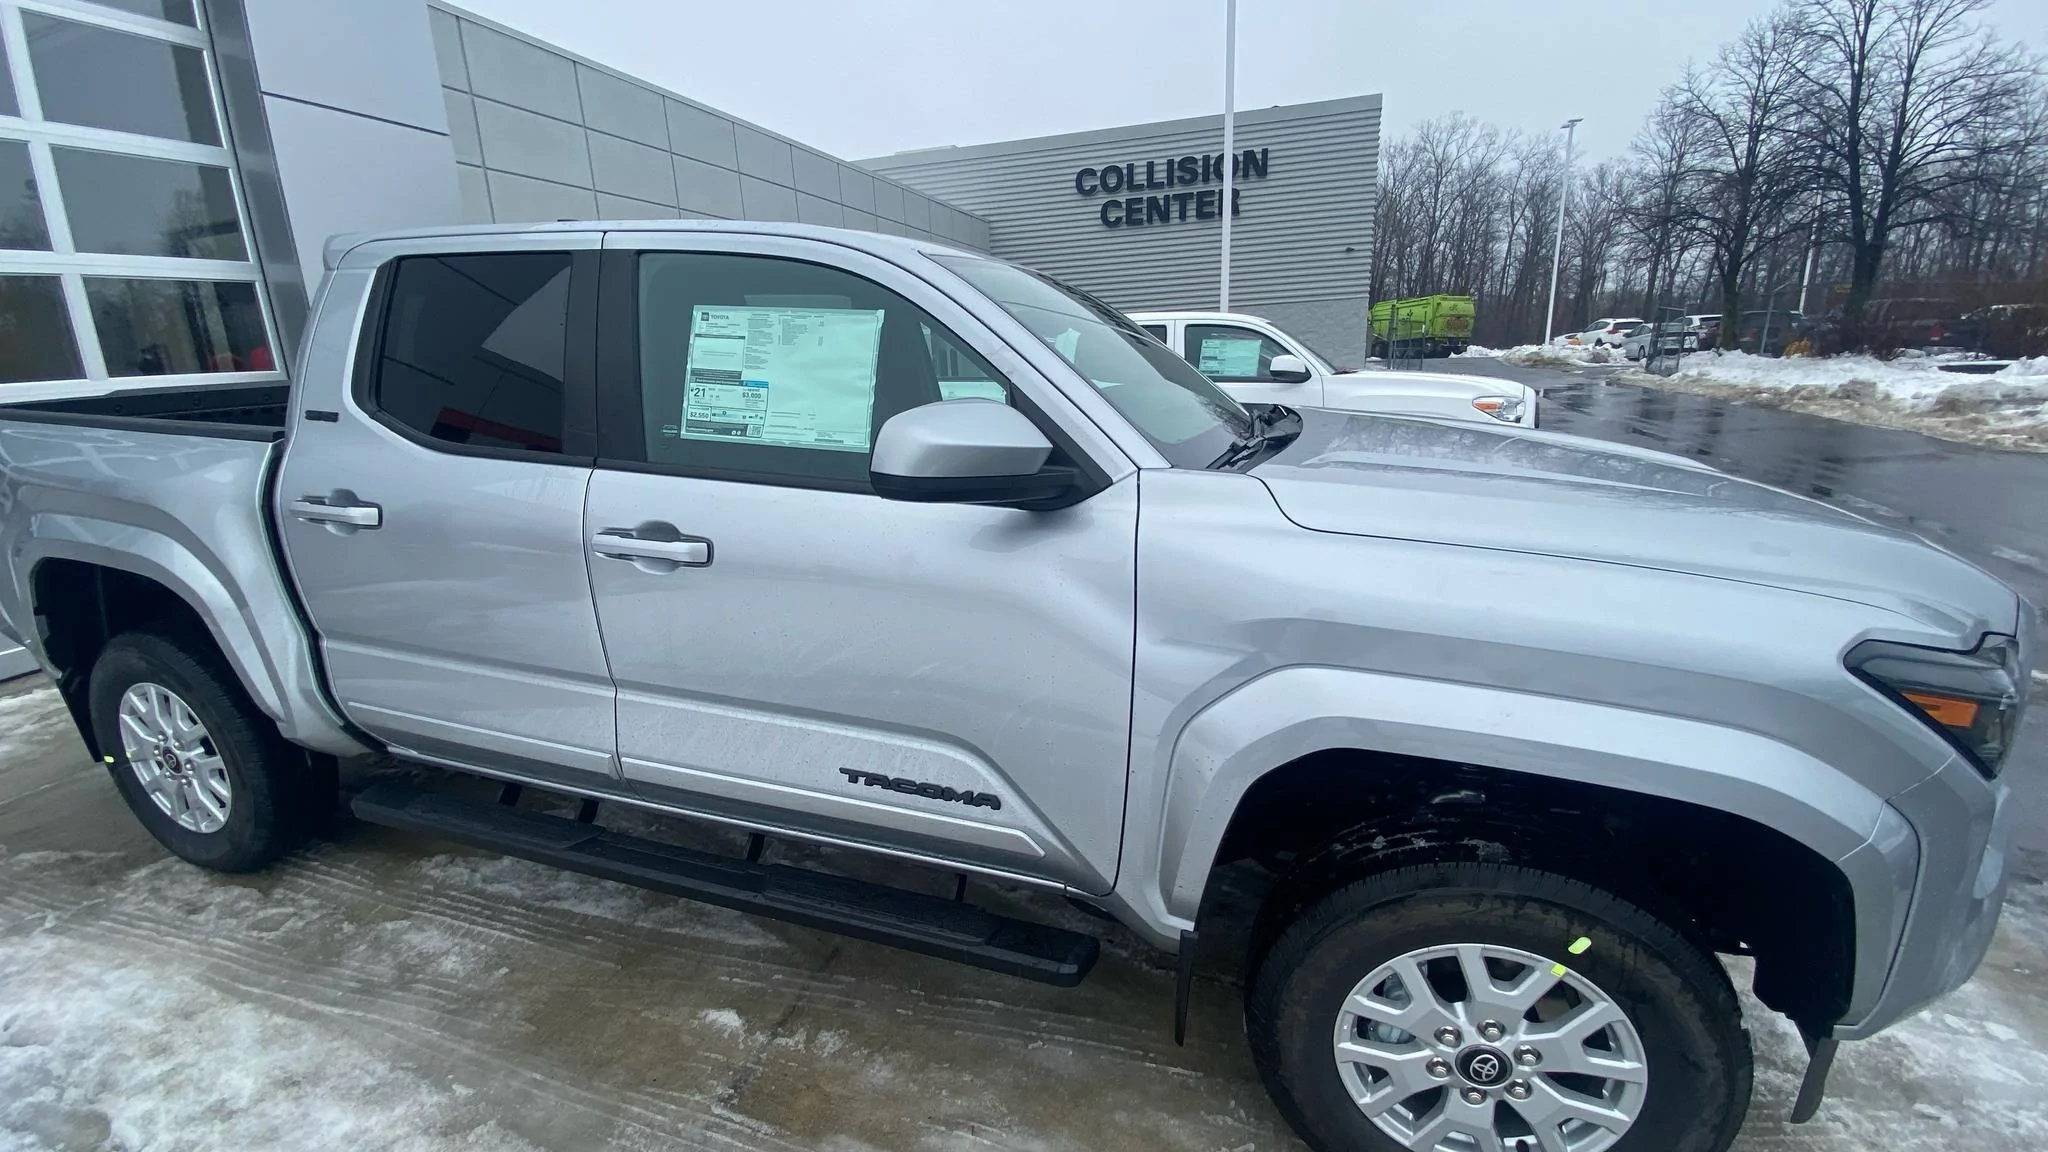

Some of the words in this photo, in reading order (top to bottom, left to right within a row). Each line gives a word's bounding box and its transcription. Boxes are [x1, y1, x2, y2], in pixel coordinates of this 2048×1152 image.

[1075, 148, 1269, 196] COLLISION
[1100, 187, 1241, 228] CENTER
[838, 767, 1002, 811] TACOMA
